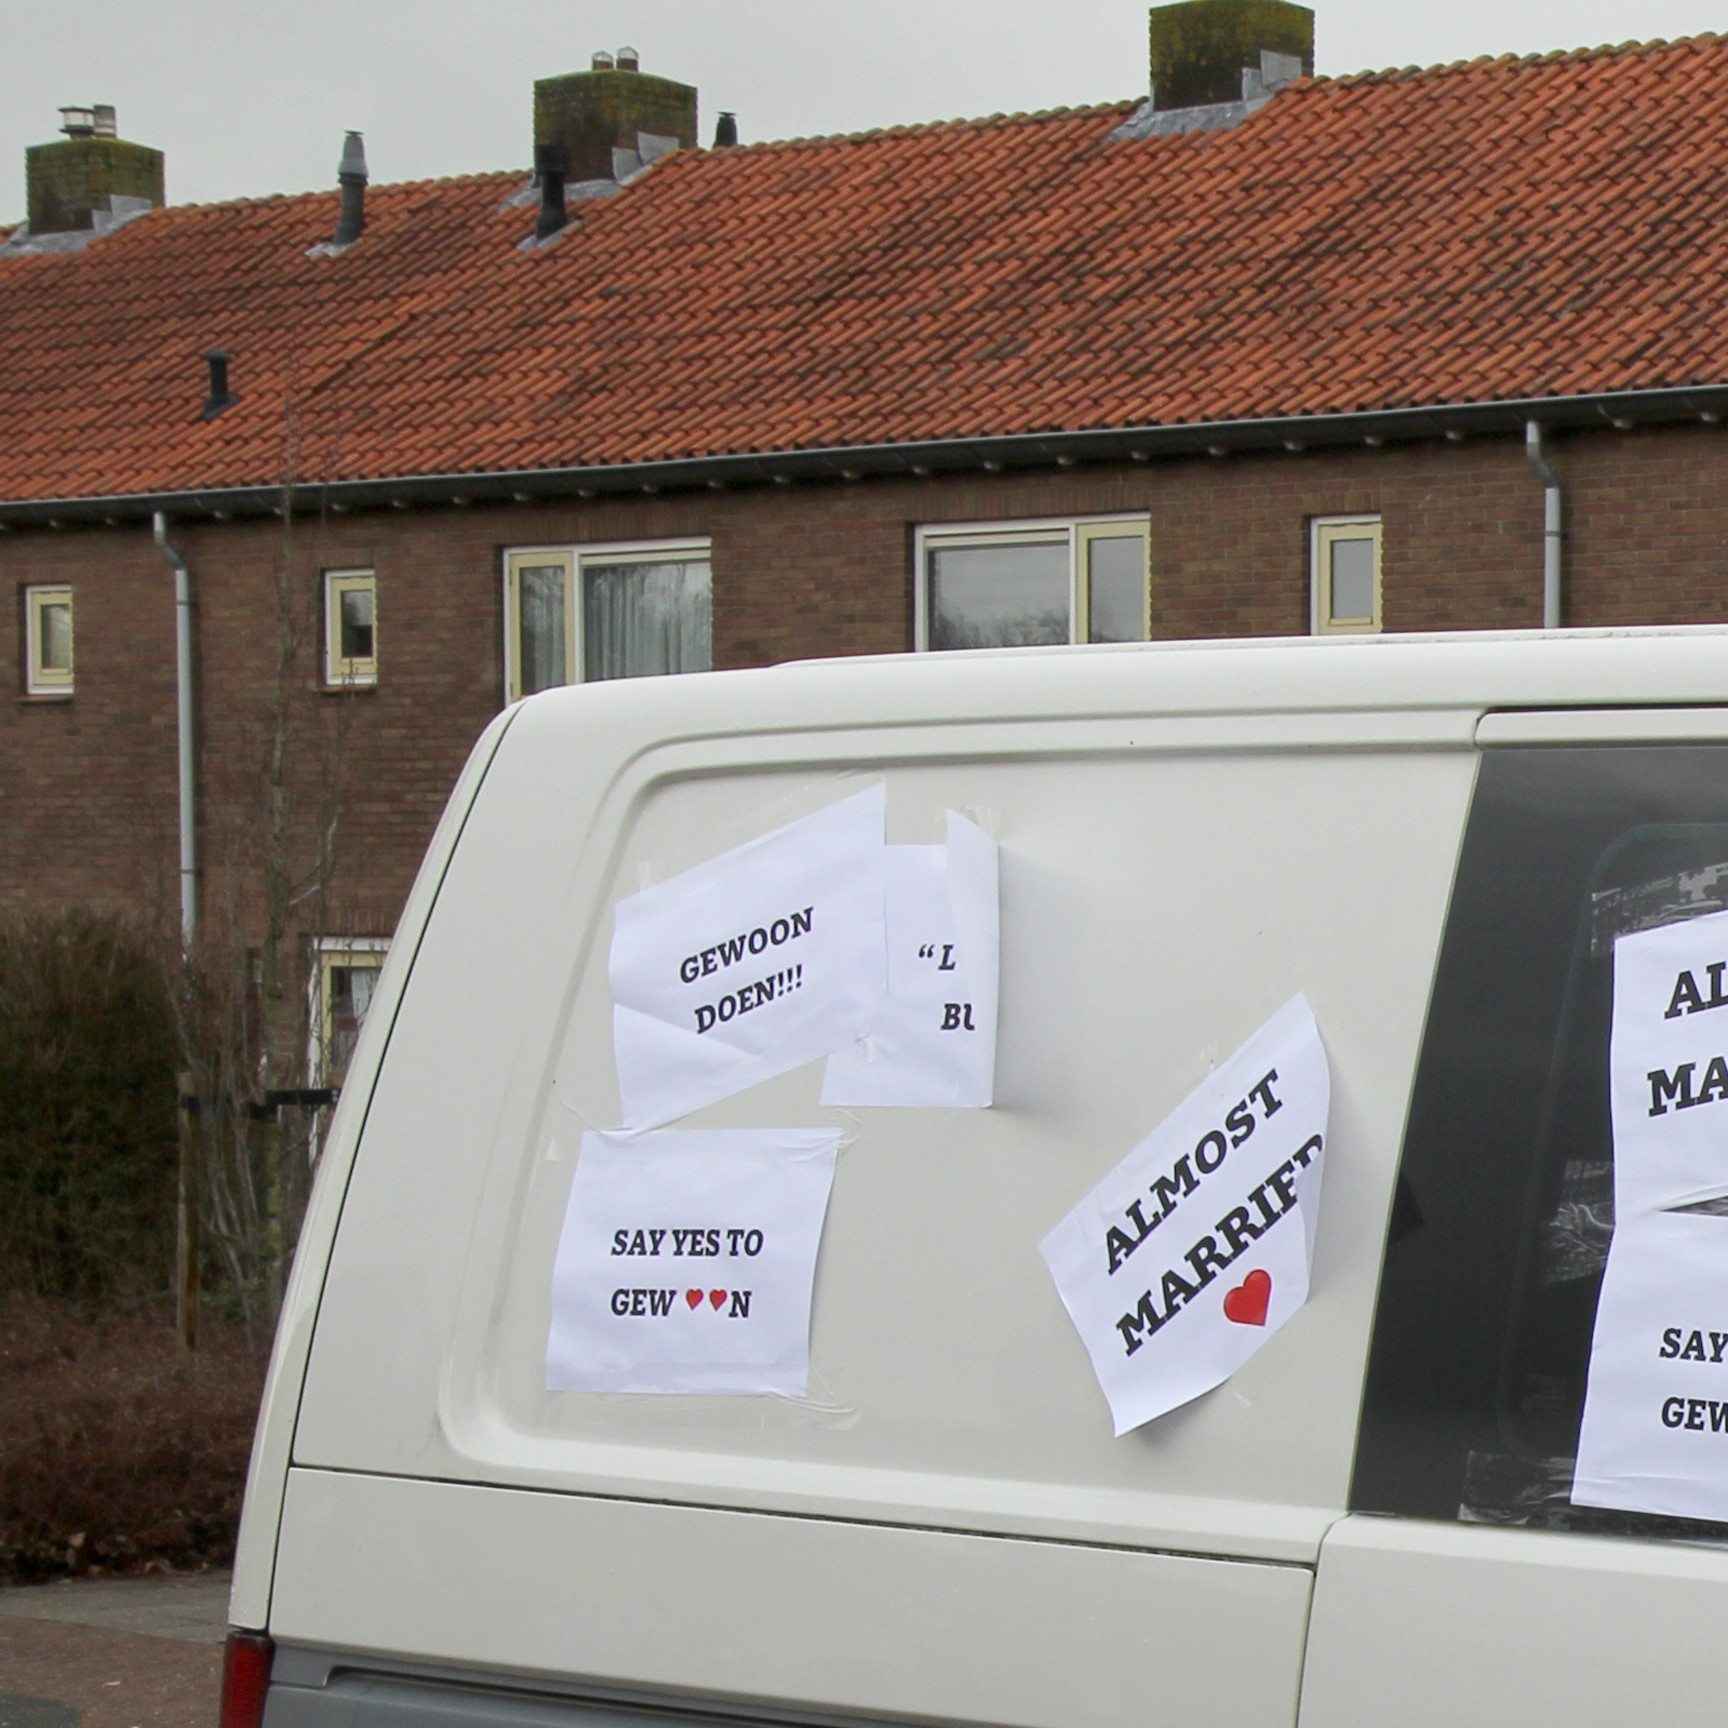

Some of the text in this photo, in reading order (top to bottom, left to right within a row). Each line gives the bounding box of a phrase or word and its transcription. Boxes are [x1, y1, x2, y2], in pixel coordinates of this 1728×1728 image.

[680, 906, 814, 984] GEWOON
[694, 964, 803, 1034] DOEN!!!
[1106, 1068, 1283, 1276] ALMOST
[611, 1228, 764, 1257] SAY YES TO
